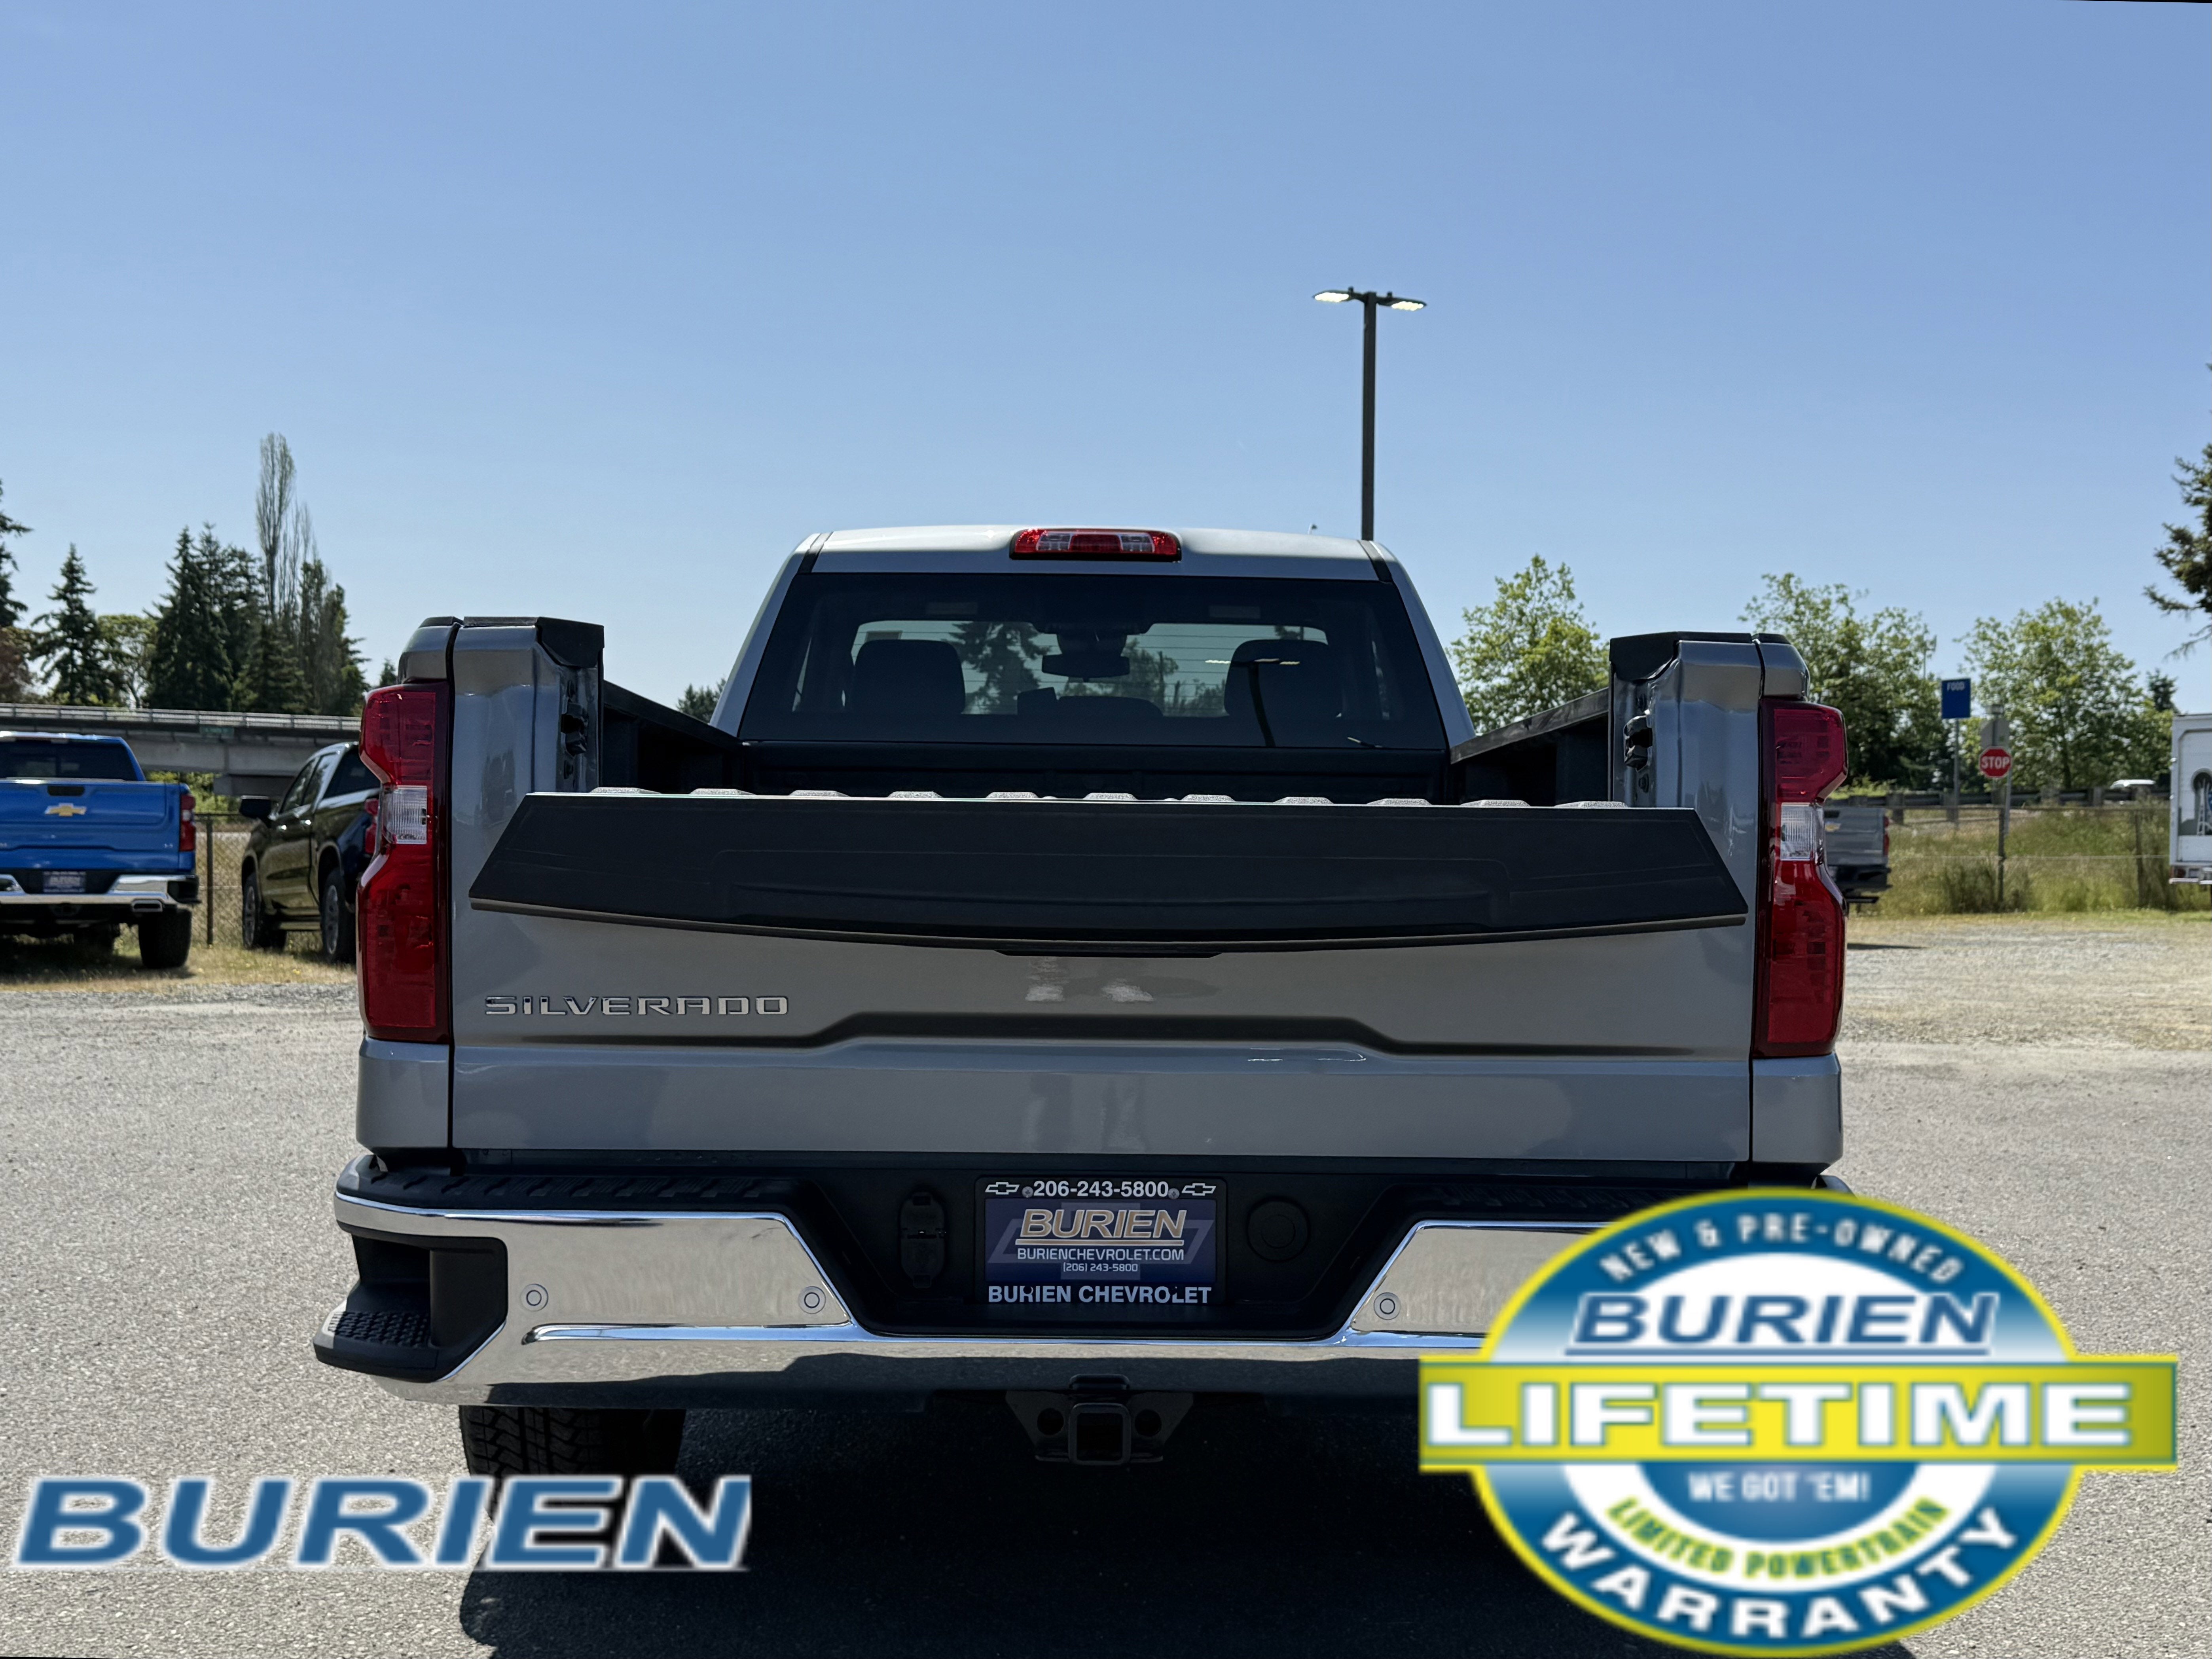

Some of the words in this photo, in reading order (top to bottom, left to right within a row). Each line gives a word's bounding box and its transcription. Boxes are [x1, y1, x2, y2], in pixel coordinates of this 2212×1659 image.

[1947, 682, 1965, 691] FOOD
[1981, 756, 2010, 769] STOP
[485, 996, 788, 1015] SILVERADO
[1033, 1181, 1169, 1197] 206-243-5800
[1020, 1209, 1187, 1238] BURIEN
[1017, 1248, 1184, 1261] BURIENCHEVROLET.COM
[1063, 1263, 1088, 1272] (206)
[1090, 1264, 1138, 1272] 243-5800
[989, 1286, 1071, 1303] BURIEN
[1079, 1286, 1211, 1304] CHEVROLET
